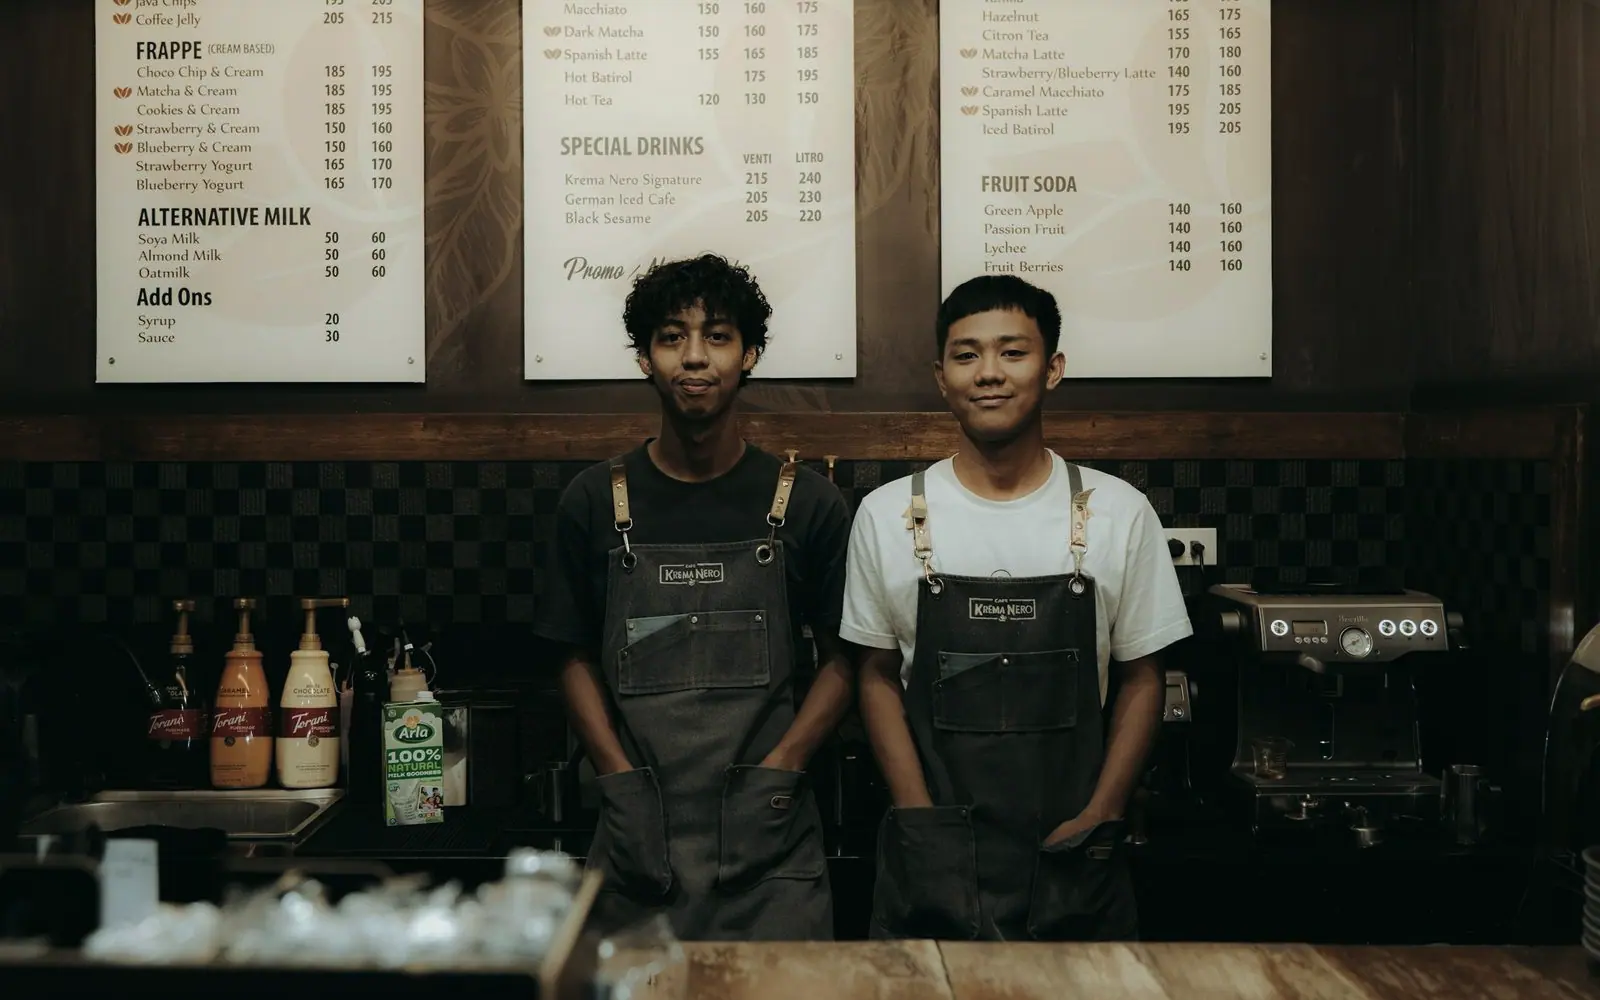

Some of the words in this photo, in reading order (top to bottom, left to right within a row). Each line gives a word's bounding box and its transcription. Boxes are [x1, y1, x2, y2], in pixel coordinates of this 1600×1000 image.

[564, 2, 627, 15] Macchiato
[698, 3, 719, 14] 150
[744, 2, 765, 14] 160
[797, 1, 818, 13] 175
[983, 10, 1039, 22] Hazelnut
[1168, 9, 1189, 21] 165
[1219, 8, 1240, 20] 175
[136, 13, 173, 25] Coffee
[178, 13, 200, 28] Jelly
[324, 12, 344, 24] 205
[372, 12, 392, 24] 215
[565, 25, 594, 37] Dark
[599, 26, 643, 37] Matcha
[699, 26, 719, 37] 150
[744, 25, 765, 36] 160
[798, 24, 817, 36] 175
[983, 30, 1023, 40] Citron
[1027, 30, 1048, 41] Tea
[1168, 28, 1189, 39] 155
[1220, 27, 1240, 39] 165
[137, 41, 201, 59] FRAPPE
[208, 44, 240, 54] (CREAM
[243, 44, 274, 54] BASED)
[564, 48, 612, 63] Spanish
[617, 49, 647, 60] Latte
[698, 48, 719, 60] 155
[744, 48, 765, 59] 165
[798, 47, 817, 58] 185
[982, 47, 1028, 60] Matcha
[1034, 49, 1065, 60] Latte
[1168, 47, 1189, 59] 170
[1220, 46, 1241, 57] 180
[137, 66, 174, 79] Choco
[179, 65, 207, 80] Chip
[224, 66, 263, 77] Cream
[325, 66, 345, 77] 185
[372, 65, 391, 77] 195
[565, 72, 587, 83] Hot
[592, 71, 632, 83] Batirol
[745, 70, 765, 82] 175
[798, 69, 818, 81] 195
[983, 66, 1119, 82] Strawberry/Blueberry
[1125, 68, 1155, 78] Latte
[1168, 66, 1189, 77] 140
[1220, 65, 1241, 76] 160
[137, 84, 180, 96] Matcha
[198, 86, 236, 96] Cream
[325, 84, 345, 96] 185
[372, 84, 392, 96] 195
[983, 85, 1035, 97] Caramel
[1040, 85, 1104, 97] Macchiato
[1169, 85, 1189, 96] 175
[1220, 84, 1241, 95] 185
[565, 94, 587, 105] Hot
[592, 95, 612, 105] Tea
[699, 94, 719, 105] 120
[745, 93, 765, 104] 130
[798, 92, 818, 103] 150
[137, 104, 183, 115] Cookies
[201, 104, 239, 115] Cream
[325, 103, 345, 114] 185
[372, 103, 391, 114] 195
[983, 104, 1031, 119] Spanish
[1037, 105, 1068, 116] Latte
[1168, 104, 1189, 115] 195
[1220, 103, 1240, 114] 205
[137, 122, 202, 137] Strawberry
[221, 123, 259, 133] Cream
[325, 122, 345, 133] 150
[372, 122, 392, 133] 160
[983, 123, 1008, 134] Iced
[1013, 123, 1053, 135] Batirol
[1168, 122, 1189, 134] 195
[1219, 122, 1241, 133] 205
[138, 141, 194, 156] Blueberry
[213, 142, 251, 152] Cream
[325, 141, 345, 152] 150
[372, 141, 392, 152] 160
[561, 137, 632, 155] SPECIAL
[638, 137, 704, 155] DRINKS
[136, 160, 207, 174] Strawberry
[212, 160, 252, 174] Yogurt
[325, 158, 344, 170] 165
[372, 158, 392, 170] 170
[743, 154, 771, 164] VENTI
[796, 153, 823, 163] LITRO
[137, 178, 198, 193] Blueberry
[203, 179, 243, 193] Yogurt
[325, 177, 344, 189] 165
[372, 177, 392, 189] 170
[565, 174, 604, 185] Krema
[610, 174, 638, 185] Nero
[643, 174, 701, 188] Signature
[746, 172, 767, 184] 215
[799, 172, 821, 184] 240
[982, 176, 1029, 192] FRUIT
[1034, 176, 1077, 192] SODA
[565, 194, 614, 206] German
[620, 192, 643, 205] Iced
[649, 192, 675, 205] Cafe
[746, 191, 767, 203] 205
[800, 191, 821, 203] 230
[138, 208, 258, 226] ALTERNATIVE
[265, 207, 311, 225] MILK
[566, 211, 598, 224] Black
[604, 212, 651, 224] Sesame
[746, 210, 768, 222] 205
[800, 210, 821, 221] 220
[984, 205, 1021, 215] Green
[1027, 204, 1063, 219] Apple
[1169, 203, 1190, 215] 140
[1220, 203, 1242, 214] 160
[985, 224, 1030, 234] Passion
[1036, 224, 1064, 234] Fruit
[1169, 222, 1190, 233] 140
[1220, 222, 1242, 233] 160
[139, 234, 167, 248] Soya
[172, 232, 199, 243] Milk
[325, 232, 338, 243] 50
[372, 232, 385, 243] 60
[139, 249, 188, 261] Almond
[193, 249, 221, 260] Milk
[326, 249, 338, 260] 50
[372, 249, 385, 260] 60
[985, 241, 1026, 256] Lychee
[1169, 241, 1190, 252] 140
[1220, 240, 1242, 252] 160
[139, 266, 189, 278] Oatmilk
[326, 266, 339, 277] 50
[372, 266, 385, 277] 60
[563, 256, 624, 281] Promo
[985, 261, 1014, 271] Fruit
[1020, 261, 1063, 272] Berries
[1169, 260, 1190, 271] 140
[1220, 259, 1242, 271] 160
[137, 288, 172, 306] Add
[178, 288, 212, 305] Ons
[139, 315, 175, 329] Syrup
[326, 314, 339, 325] 20
[139, 332, 174, 342] Sauce
[326, 330, 339, 342] 30
[664, 569, 695, 581] KREMA
[695, 568, 720, 580] NERO
[974, 603, 1006, 616] KREMA
[1006, 604, 1033, 616] NERO
[213, 712, 248, 733] Torani
[292, 712, 328, 734] Torani
[398, 726, 428, 739] Arla
[388, 749, 441, 764] 100%
[388, 762, 441, 773] NATURAL
